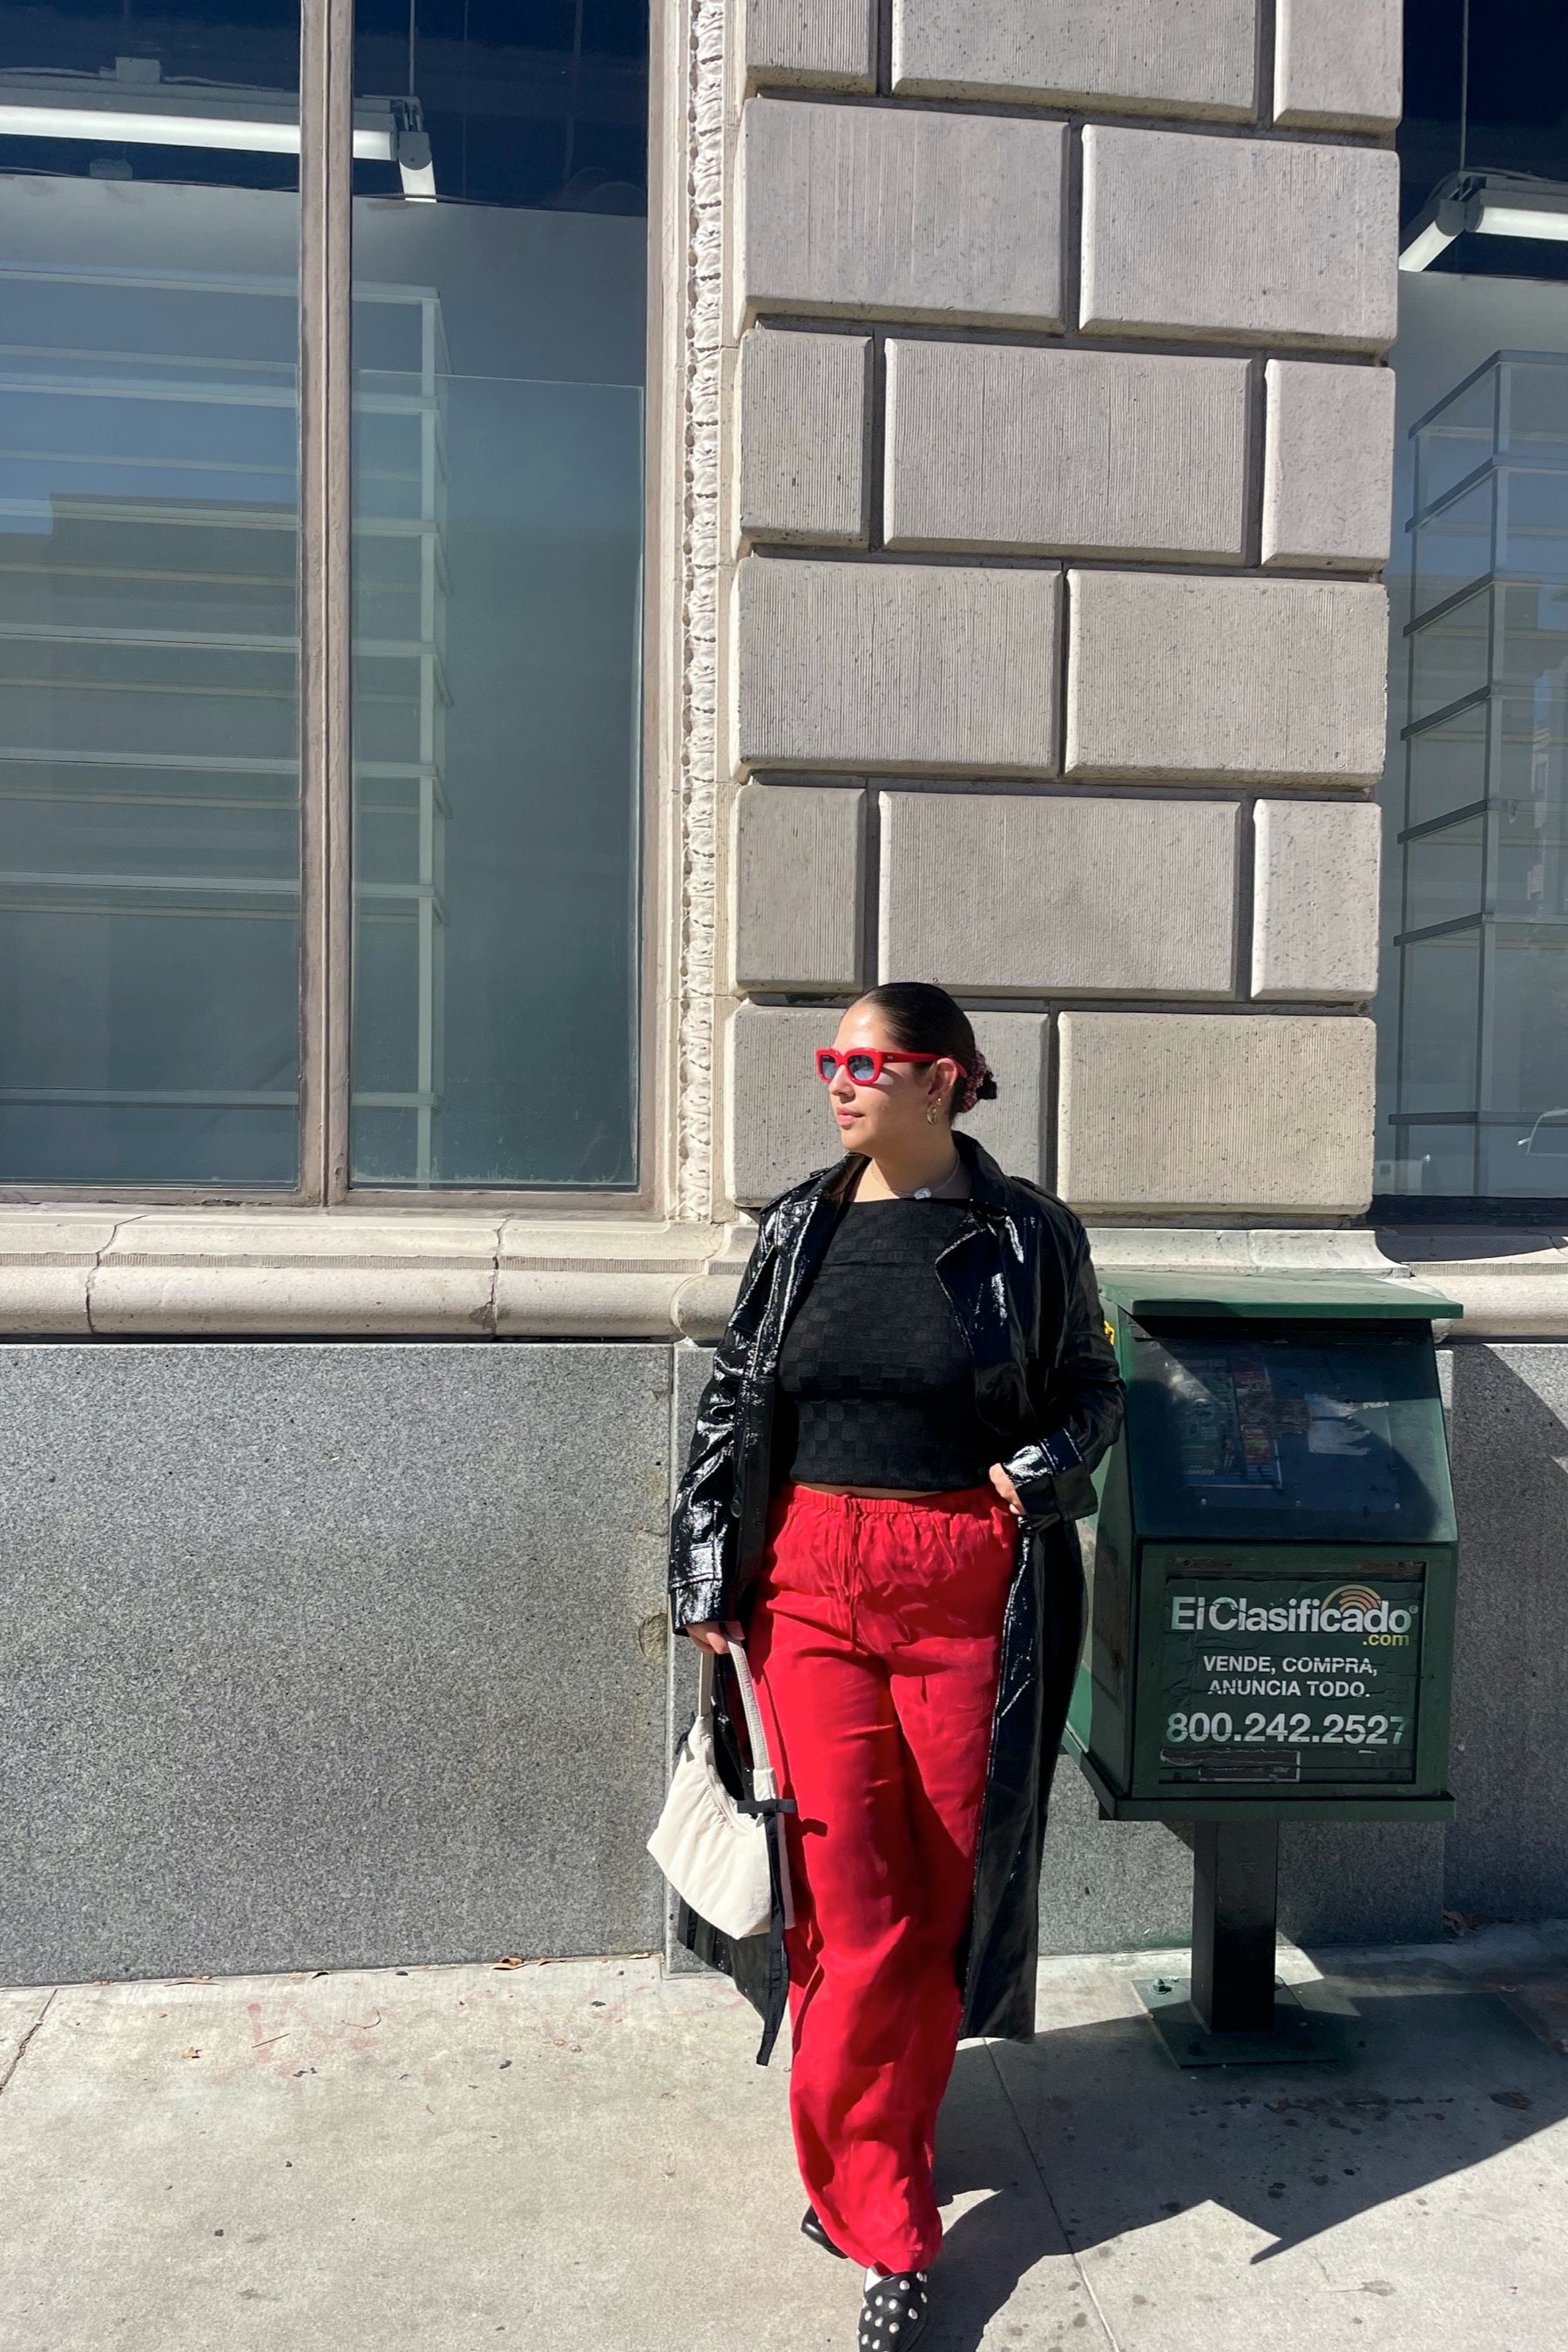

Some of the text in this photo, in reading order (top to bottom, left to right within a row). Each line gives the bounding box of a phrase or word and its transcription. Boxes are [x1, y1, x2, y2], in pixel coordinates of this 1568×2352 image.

[1362, 1633, 1409, 1646] .com
[1203, 1655, 1378, 1677] VENDE, COMPRA,
[1207, 1680, 1371, 1698] ANUNCIA TODO.
[1166, 1712, 1409, 1745] 800.242.2527
